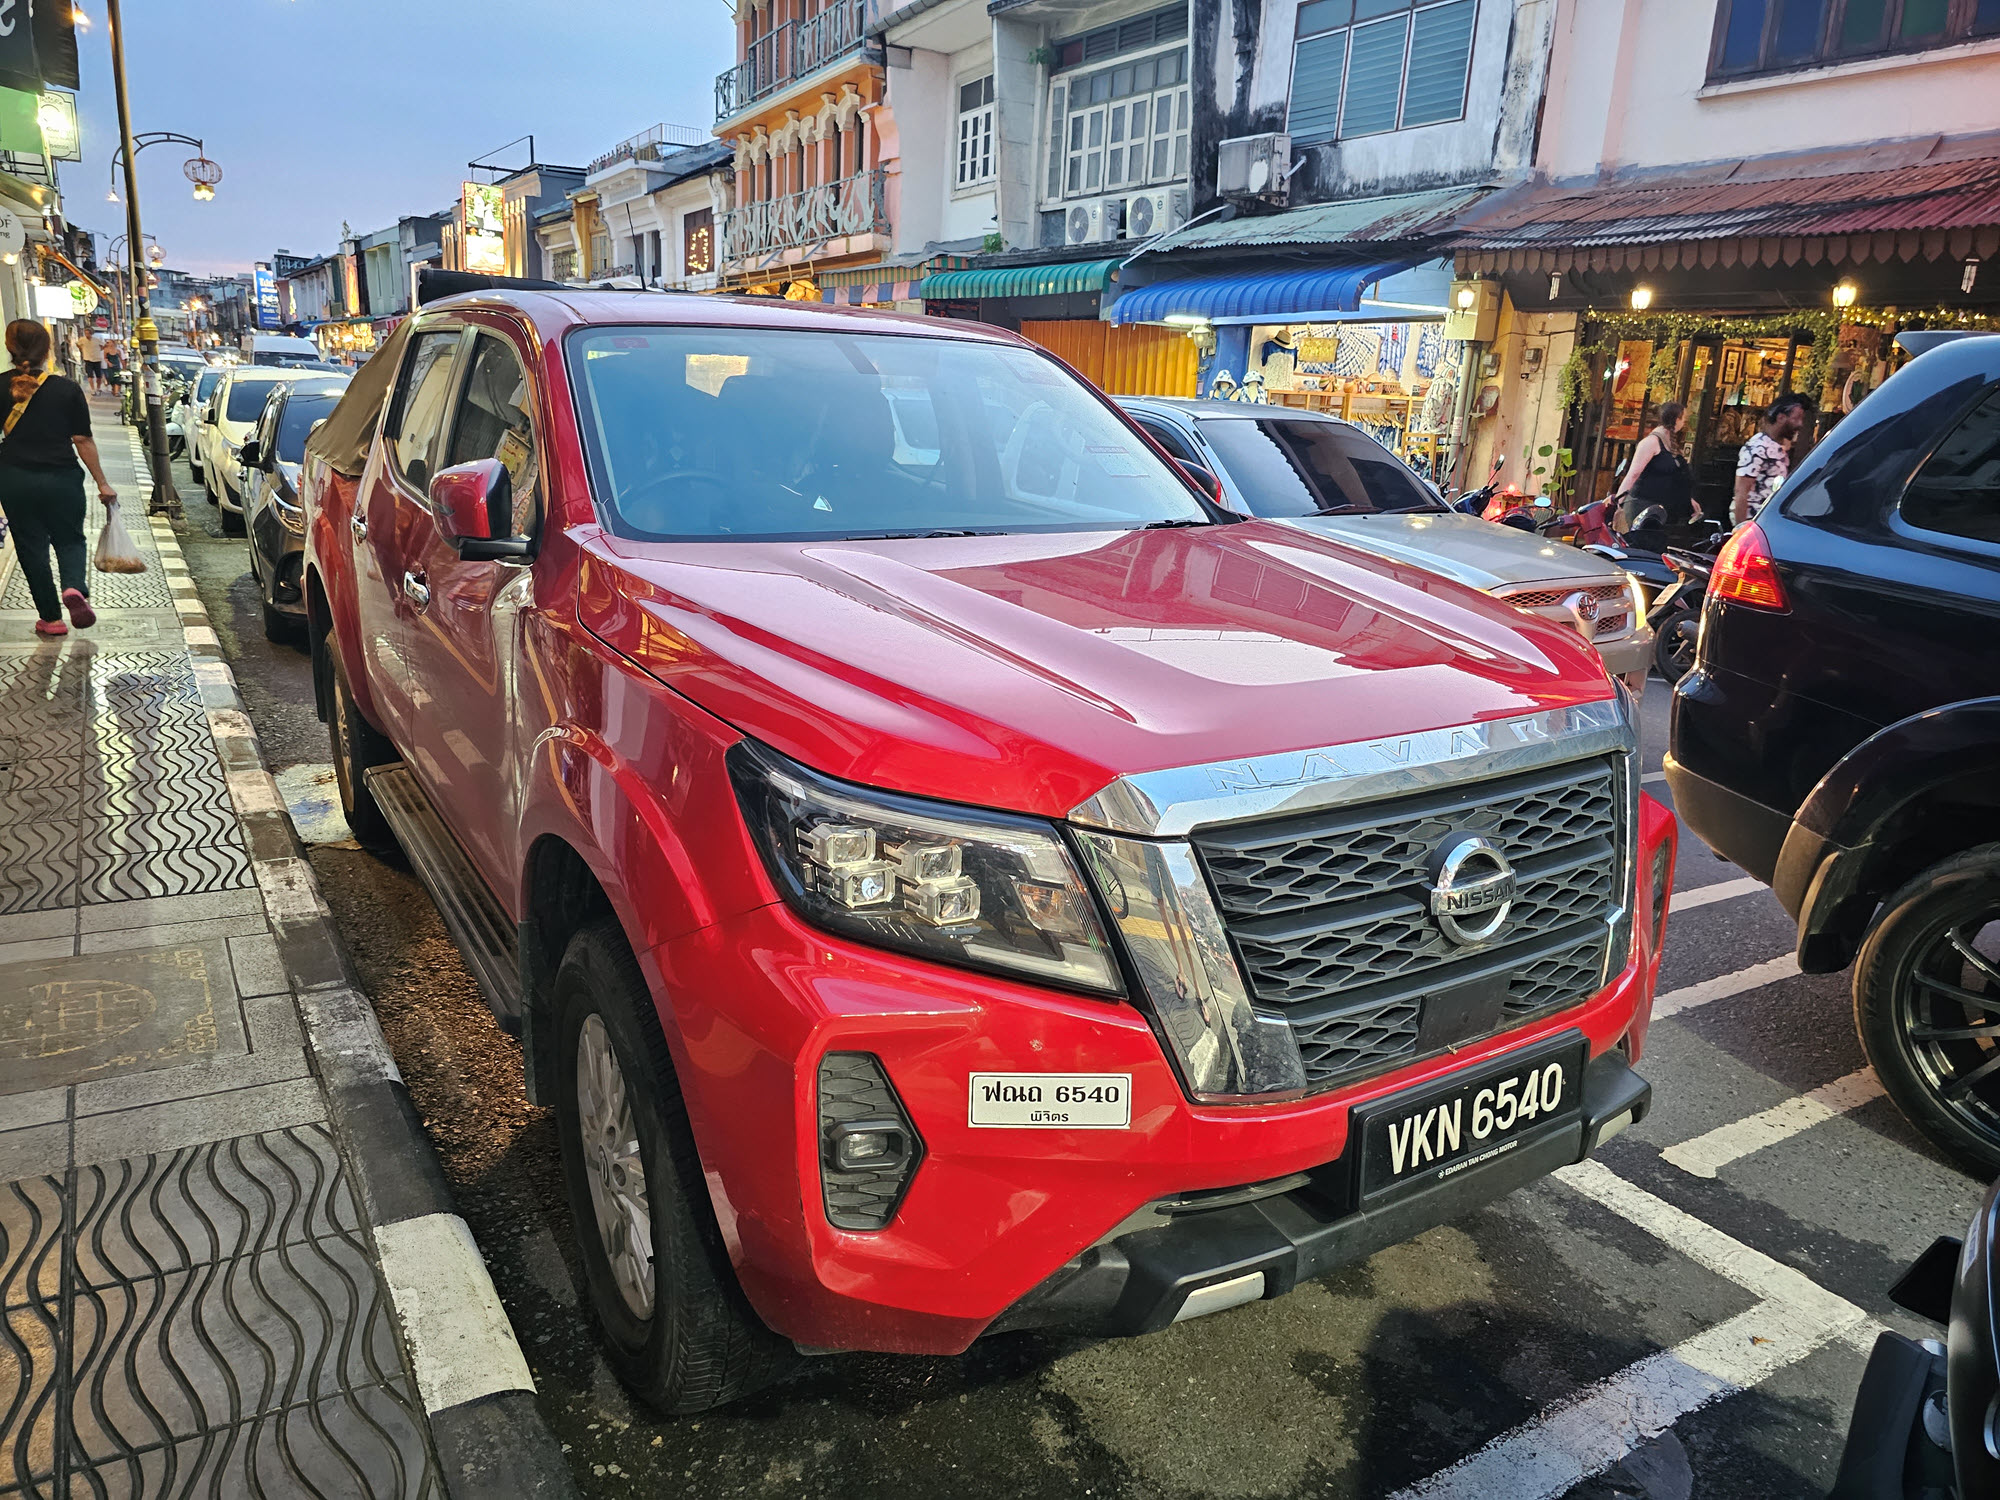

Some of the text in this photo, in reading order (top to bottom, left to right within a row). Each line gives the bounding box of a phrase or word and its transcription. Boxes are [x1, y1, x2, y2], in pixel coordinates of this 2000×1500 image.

[1205, 709, 1600, 792] NAVARA
[1447, 882, 1515, 910] NISSAN
[982, 1081, 1119, 1103] ฟณถ 6540
[1030, 1110, 1069, 1122] พิจิตร
[1388, 1062, 1563, 1175] VKN 6540
[1445, 1140, 1518, 1176] EDARAN TAN CHONG MOTOR
